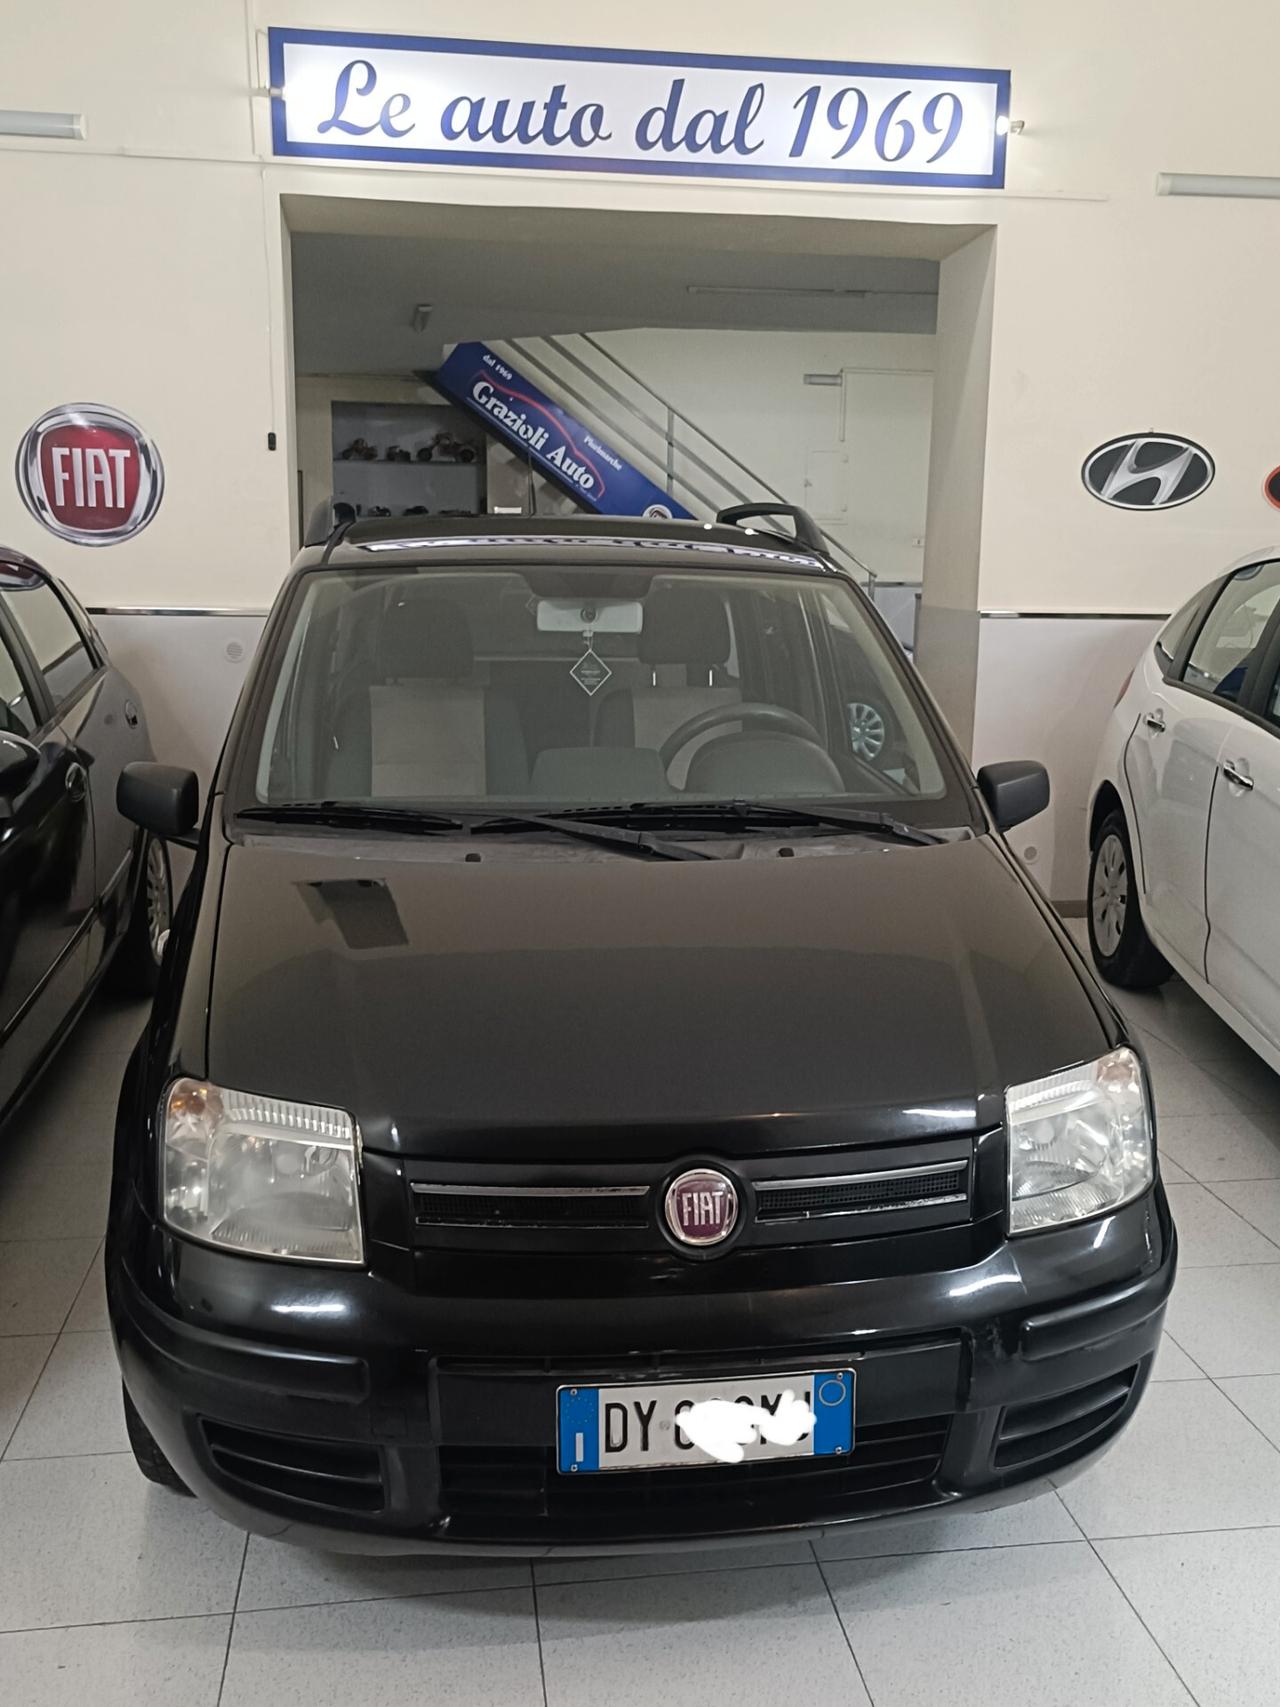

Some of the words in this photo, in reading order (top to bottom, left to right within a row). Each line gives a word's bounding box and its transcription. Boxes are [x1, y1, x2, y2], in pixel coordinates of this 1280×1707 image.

[317, 59, 415, 138] Le
[440, 84, 612, 149] auto
[634, 78, 764, 156] dal
[788, 84, 964, 164] 1969
[482, 354, 495, 366] dal
[496, 364, 512, 380] 1969
[472, 381, 549, 450] Grazioli
[546, 445, 595, 490] Auto
[51, 447, 131, 509] FIAT
[682, 1191, 724, 1226] FIAT
[604, 1400, 657, 1453] DY
